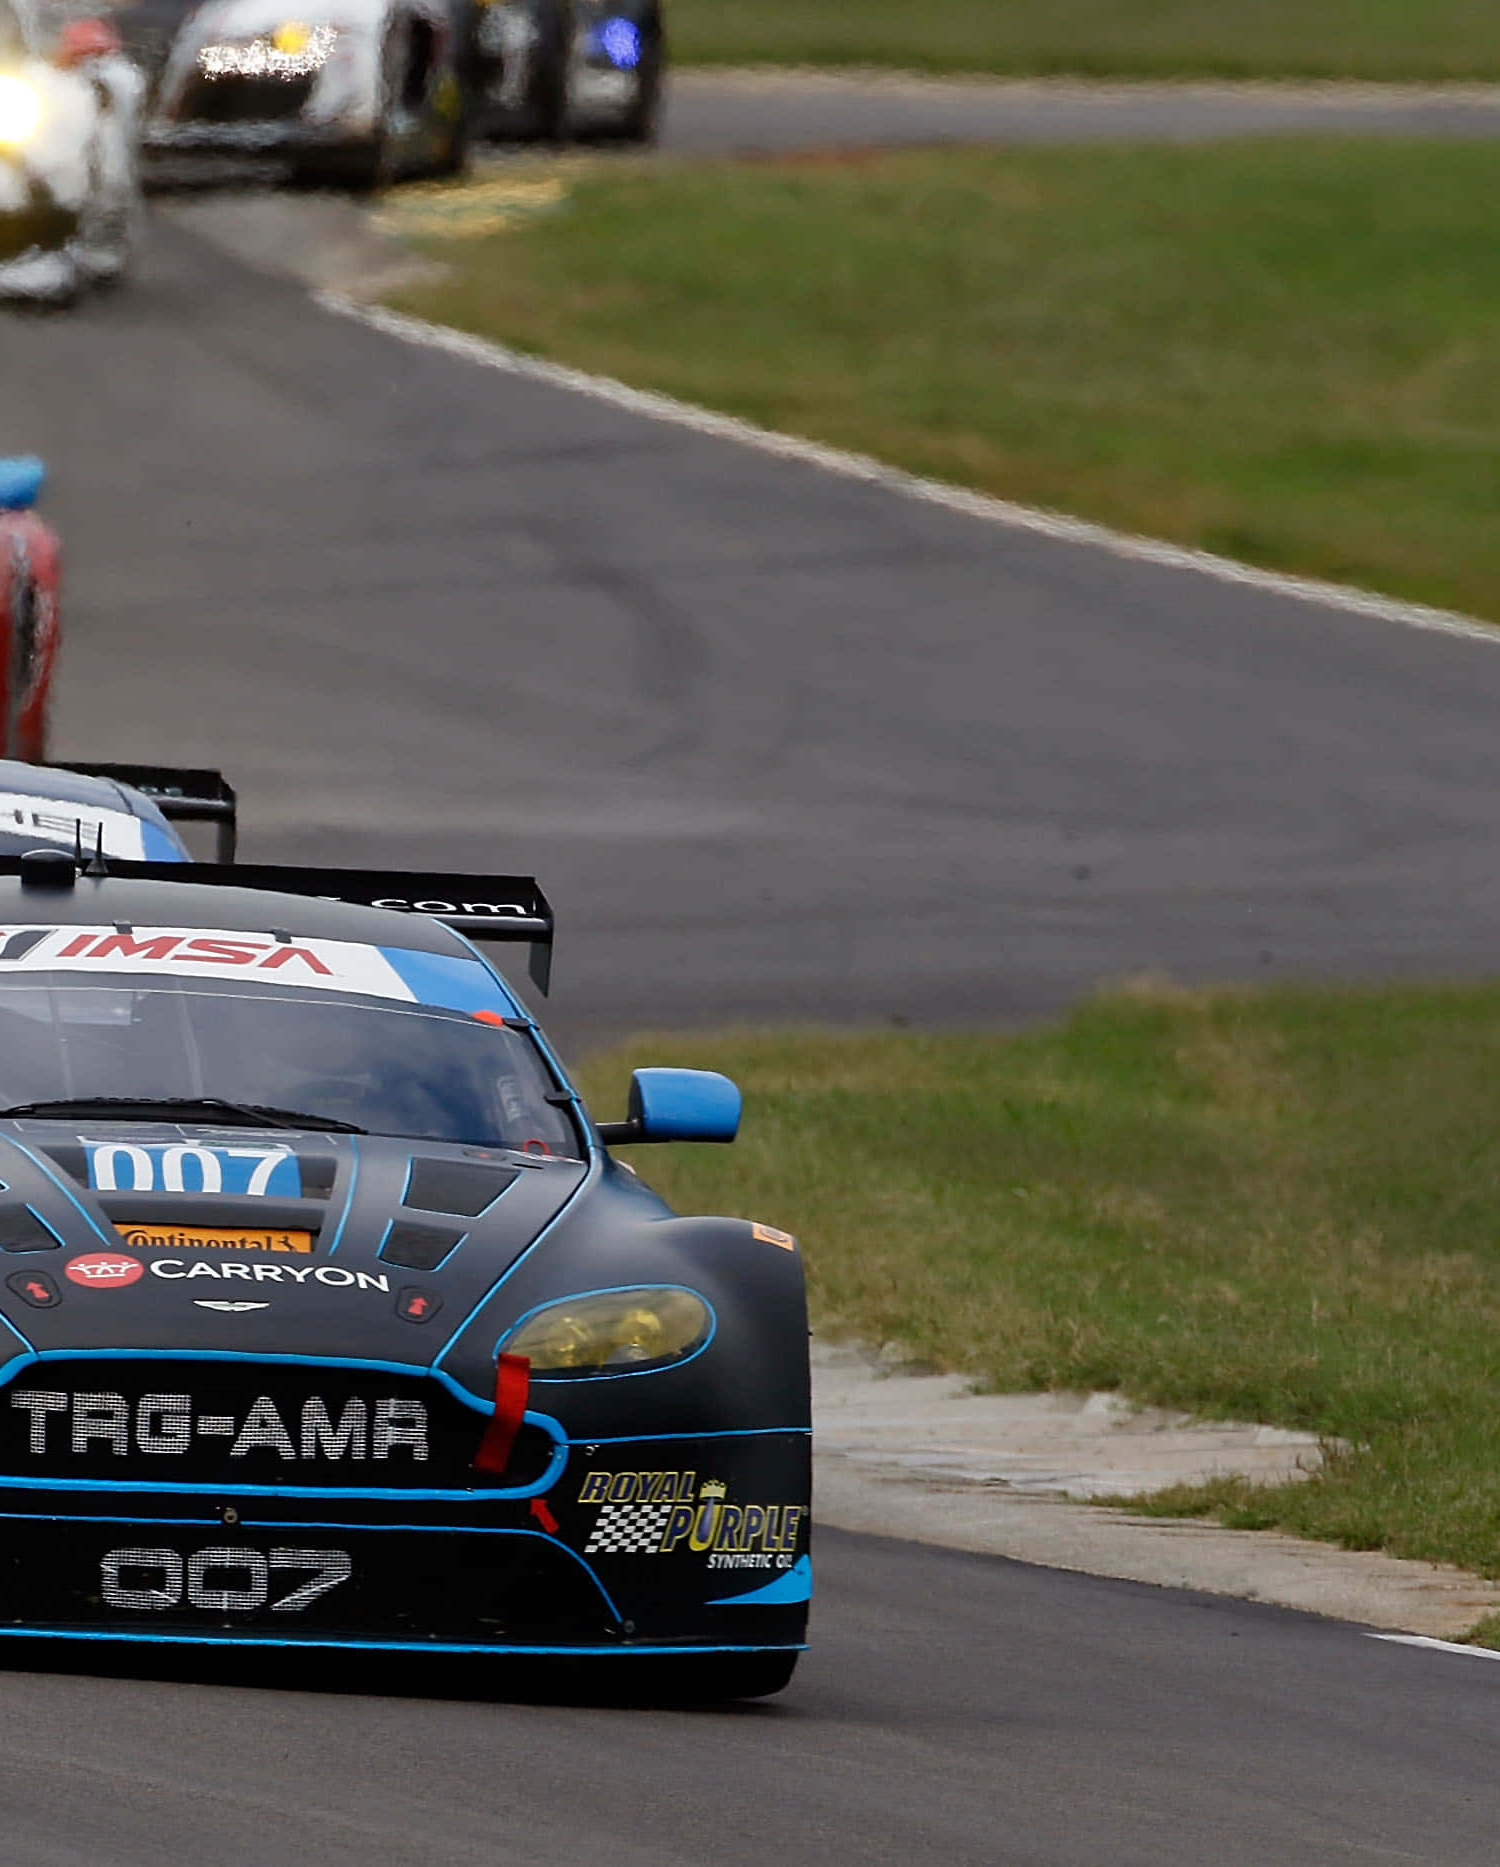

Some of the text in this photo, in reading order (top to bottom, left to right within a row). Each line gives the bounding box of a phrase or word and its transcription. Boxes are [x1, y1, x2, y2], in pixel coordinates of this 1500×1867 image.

[56, 933, 334, 976] IMSA
[93, 1145, 288, 1197] 007
[150, 1258, 391, 1292] CARRYON
[10, 1391, 430, 1461] TRG-AMR
[577, 1471, 697, 1503] ROYAL
[659, 1504, 802, 1552] PURPLE
[100, 1546, 353, 1612] 007
[706, 1553, 772, 1569] SYNTHETIC
